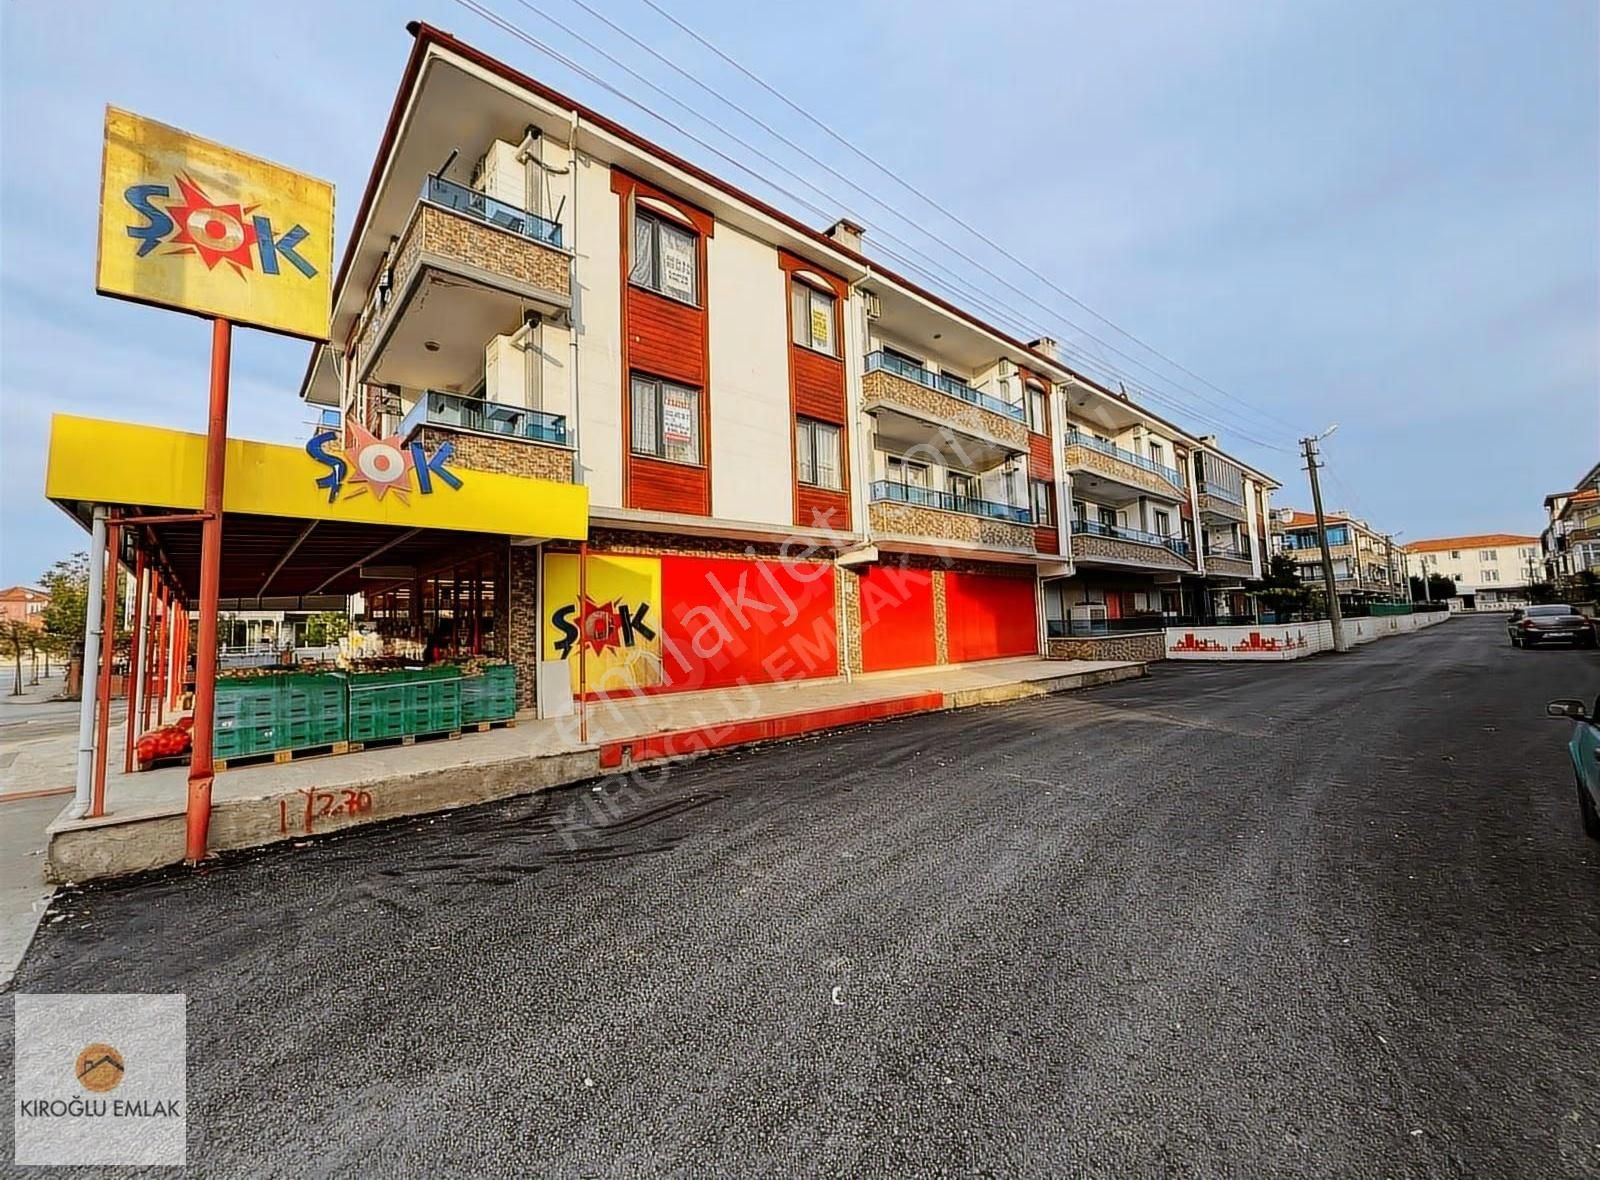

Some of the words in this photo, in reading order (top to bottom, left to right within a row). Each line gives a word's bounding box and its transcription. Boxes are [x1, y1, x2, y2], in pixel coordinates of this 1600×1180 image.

[124, 171, 318, 279] ŞOK
[306, 418, 464, 504] ŞOK
[552, 597, 656, 660] ŞOK
